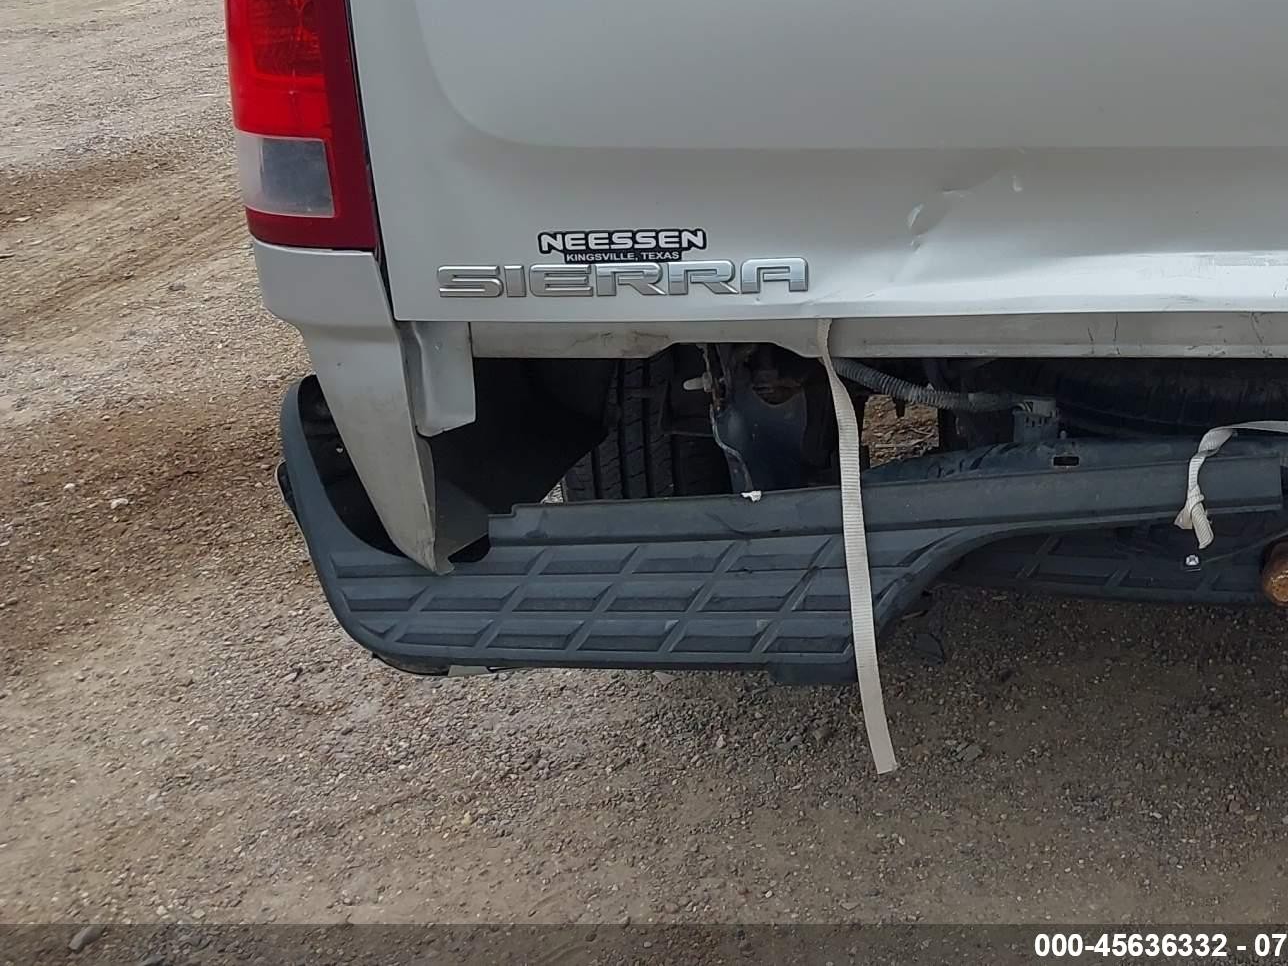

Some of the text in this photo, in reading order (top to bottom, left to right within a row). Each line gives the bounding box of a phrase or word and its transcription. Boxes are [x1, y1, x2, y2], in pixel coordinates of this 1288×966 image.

[539, 229, 706, 253] NEESSEN
[565, 251, 680, 263] KINGSVILLE, TEXAS
[437, 257, 809, 298] SIERRA
